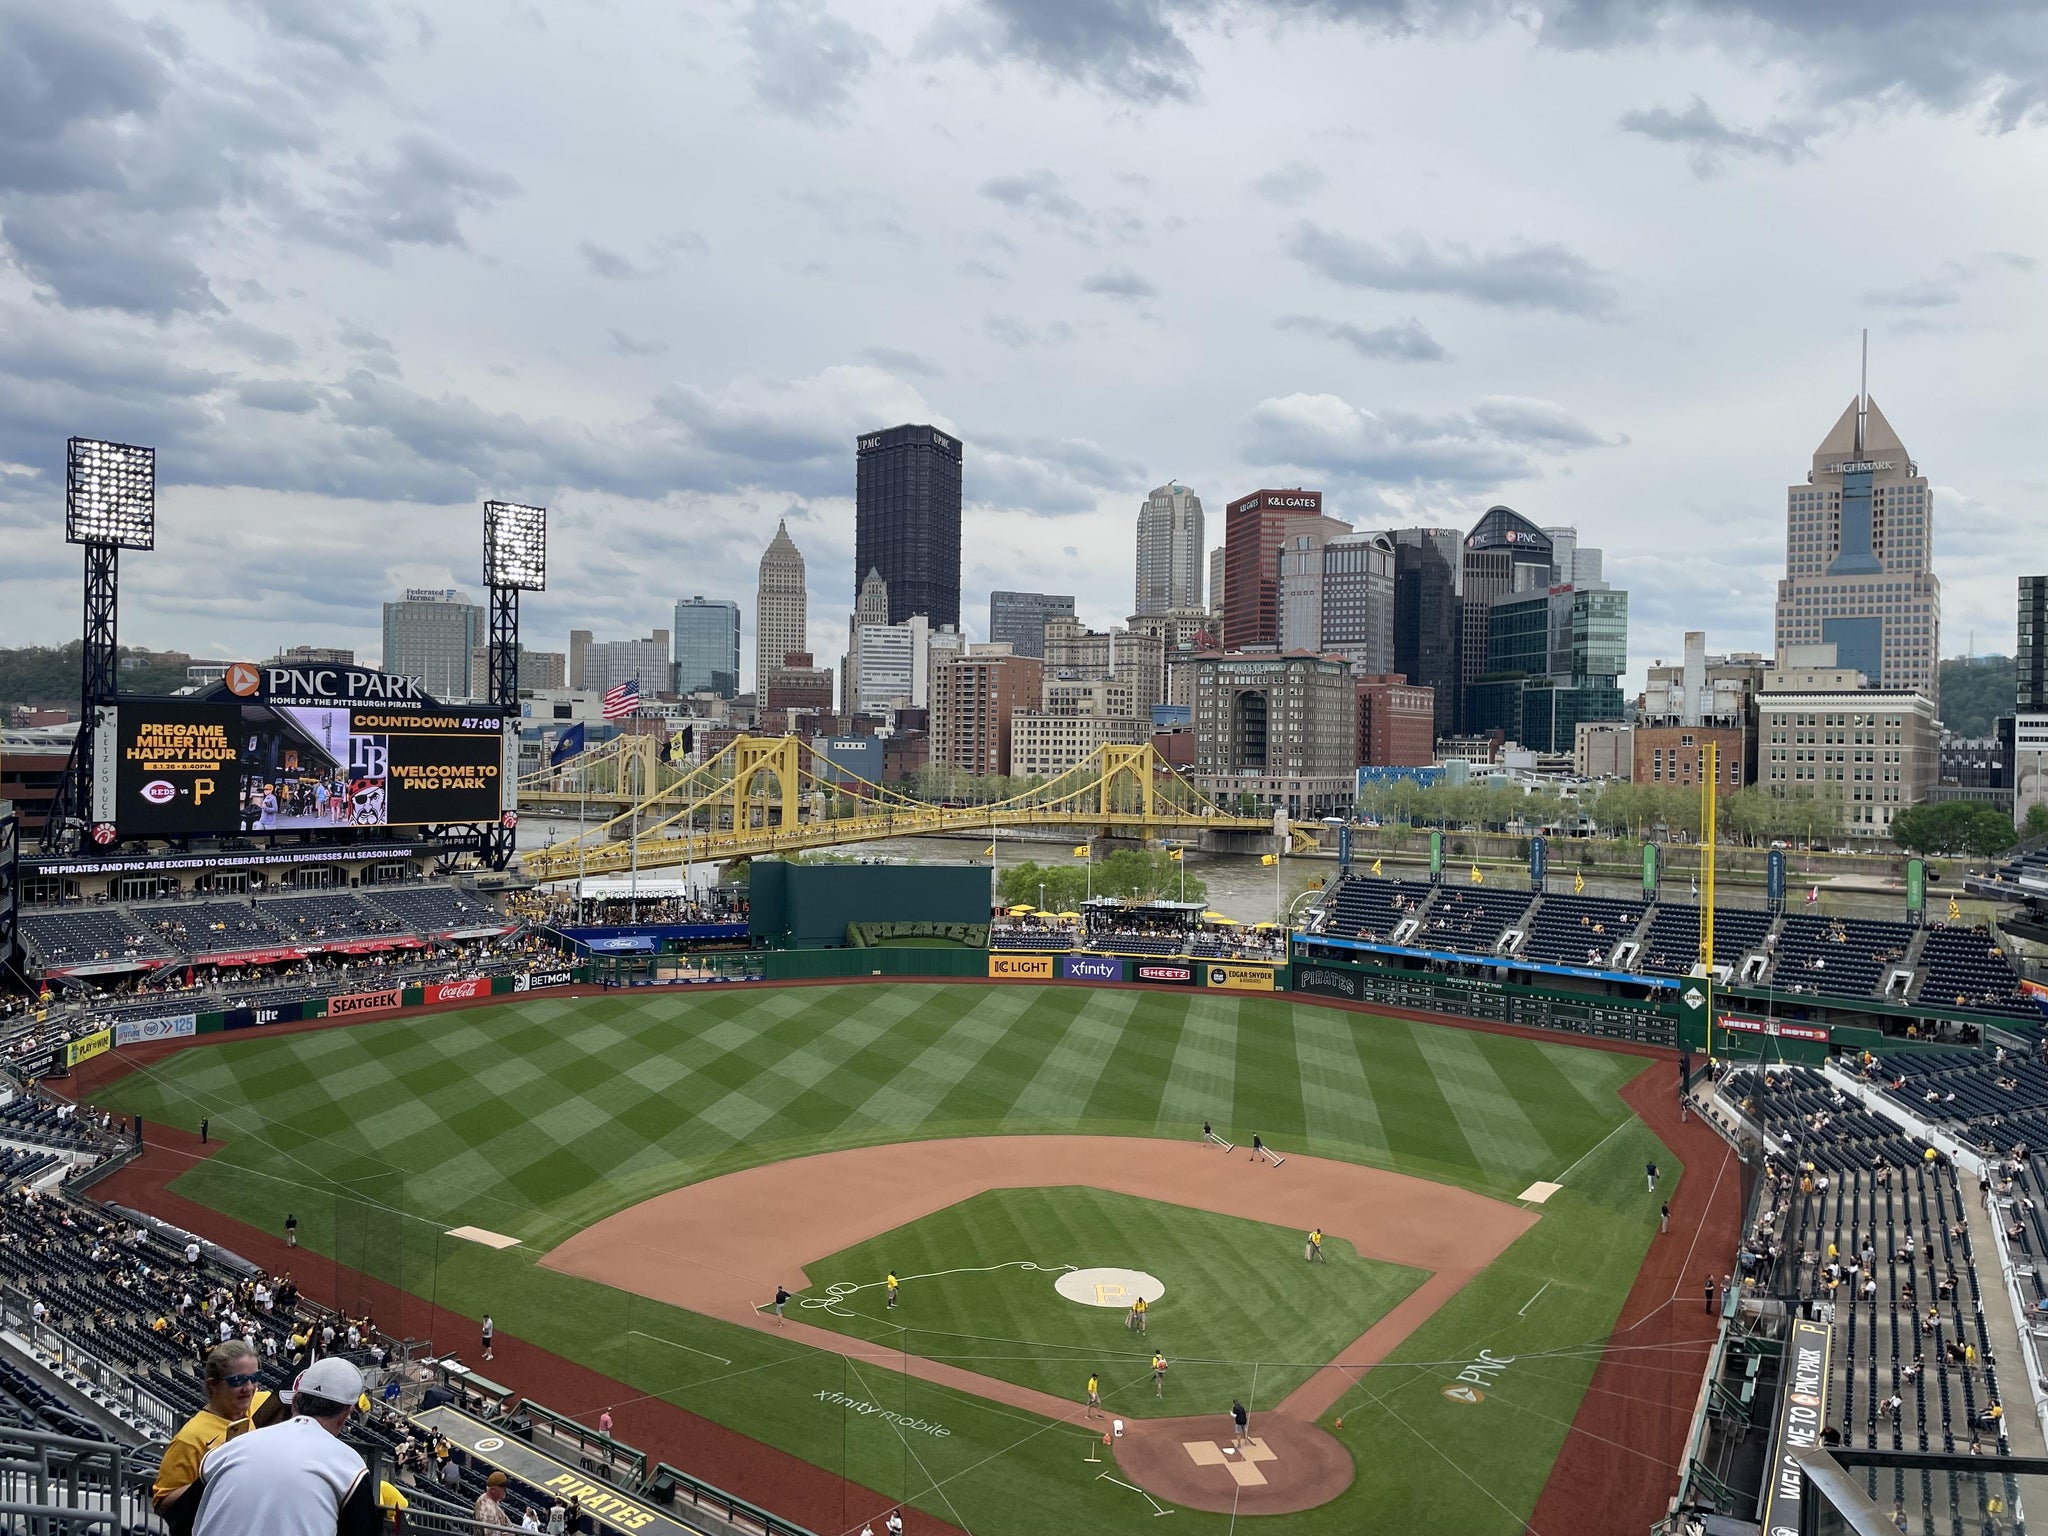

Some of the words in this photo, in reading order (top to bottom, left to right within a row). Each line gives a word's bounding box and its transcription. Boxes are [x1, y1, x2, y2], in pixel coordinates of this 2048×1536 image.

[933, 433, 950, 449] UPMC
[1831, 461, 1892, 473] HIGHMARK
[1268, 497, 1285, 506] K&L
[1286, 498, 1316, 507] GATES
[1475, 534, 1487, 544] PNC
[1517, 534, 1536, 543] PNC
[266, 668, 338, 696] PNC
[345, 672, 423, 699] PARK
[269, 697, 297, 705] HOME
[314, 698, 331, 706] THE
[333, 699, 386, 708] PITTSBURGH
[388, 700, 422, 708] PIRATES
[354, 715, 460, 728] COUNTDOWN
[461, 718, 500, 729] 47:09
[141, 723, 224, 736] PREGAME
[136, 736, 194, 748] MILLER
[197, 736, 228, 748] LITE
[126, 748, 187, 760] HAPPY
[188, 748, 236, 760] HOUR
[391, 766, 475, 778] WELCOME
[477, 766, 497, 777] TO
[404, 778, 440, 790] PNC
[442, 778, 486, 789] PARK
[194, 778, 215, 806] P
[38, 866, 58, 874] THE
[59, 865, 100, 874] PIRATES
[100, 863, 123, 872] AND
[124, 862, 145, 871] PNC
[146, 861, 165, 869] ARE
[166, 859, 204, 868] EXCITED
[218, 856, 264, 866] CELEBRATE
[265, 855, 292, 864] SMALL
[293, 853, 342, 862] BUSINESSES
[343, 851, 356, 859] ALL
[357, 850, 388, 858] SEASON
[610, 890, 629, 899] FAT
[859, 921, 988, 947] PIRATES
[994, 961, 1008, 972] IC
[1011, 962, 1048, 972] LIGHT
[1071, 962, 1114, 977] xfinity
[1142, 969, 1186, 977] SHEETZ
[531, 972, 570, 986] BETMGM
[1229, 970, 1248, 978] EDGAR
[1249, 972, 1272, 980] SNYDER
[1301, 970, 1354, 995] PIRATES
[439, 982, 476, 1000] Coca-Cola
[333, 992, 397, 1013] SEATGEEK
[255, 1010, 278, 1024] Lite
[175, 1018, 192, 1032] 125
[79, 1042, 93, 1056] PLAY
[98, 1036, 109, 1048] WIN!
[1094, 1284, 1126, 1304] P
[1800, 1324, 1826, 1335] P
[1455, 1349, 1516, 1386] PNC
[1799, 1347, 1821, 1374] PARK
[1795, 1370, 1819, 1396] PNC
[813, 1390, 880, 1414] xfinity
[879, 1411, 950, 1438] mobile
[1788, 1406, 1817, 1426] TO
[544, 1473, 656, 1529] PIRATES
[552, 1514, 562, 1522] 69
